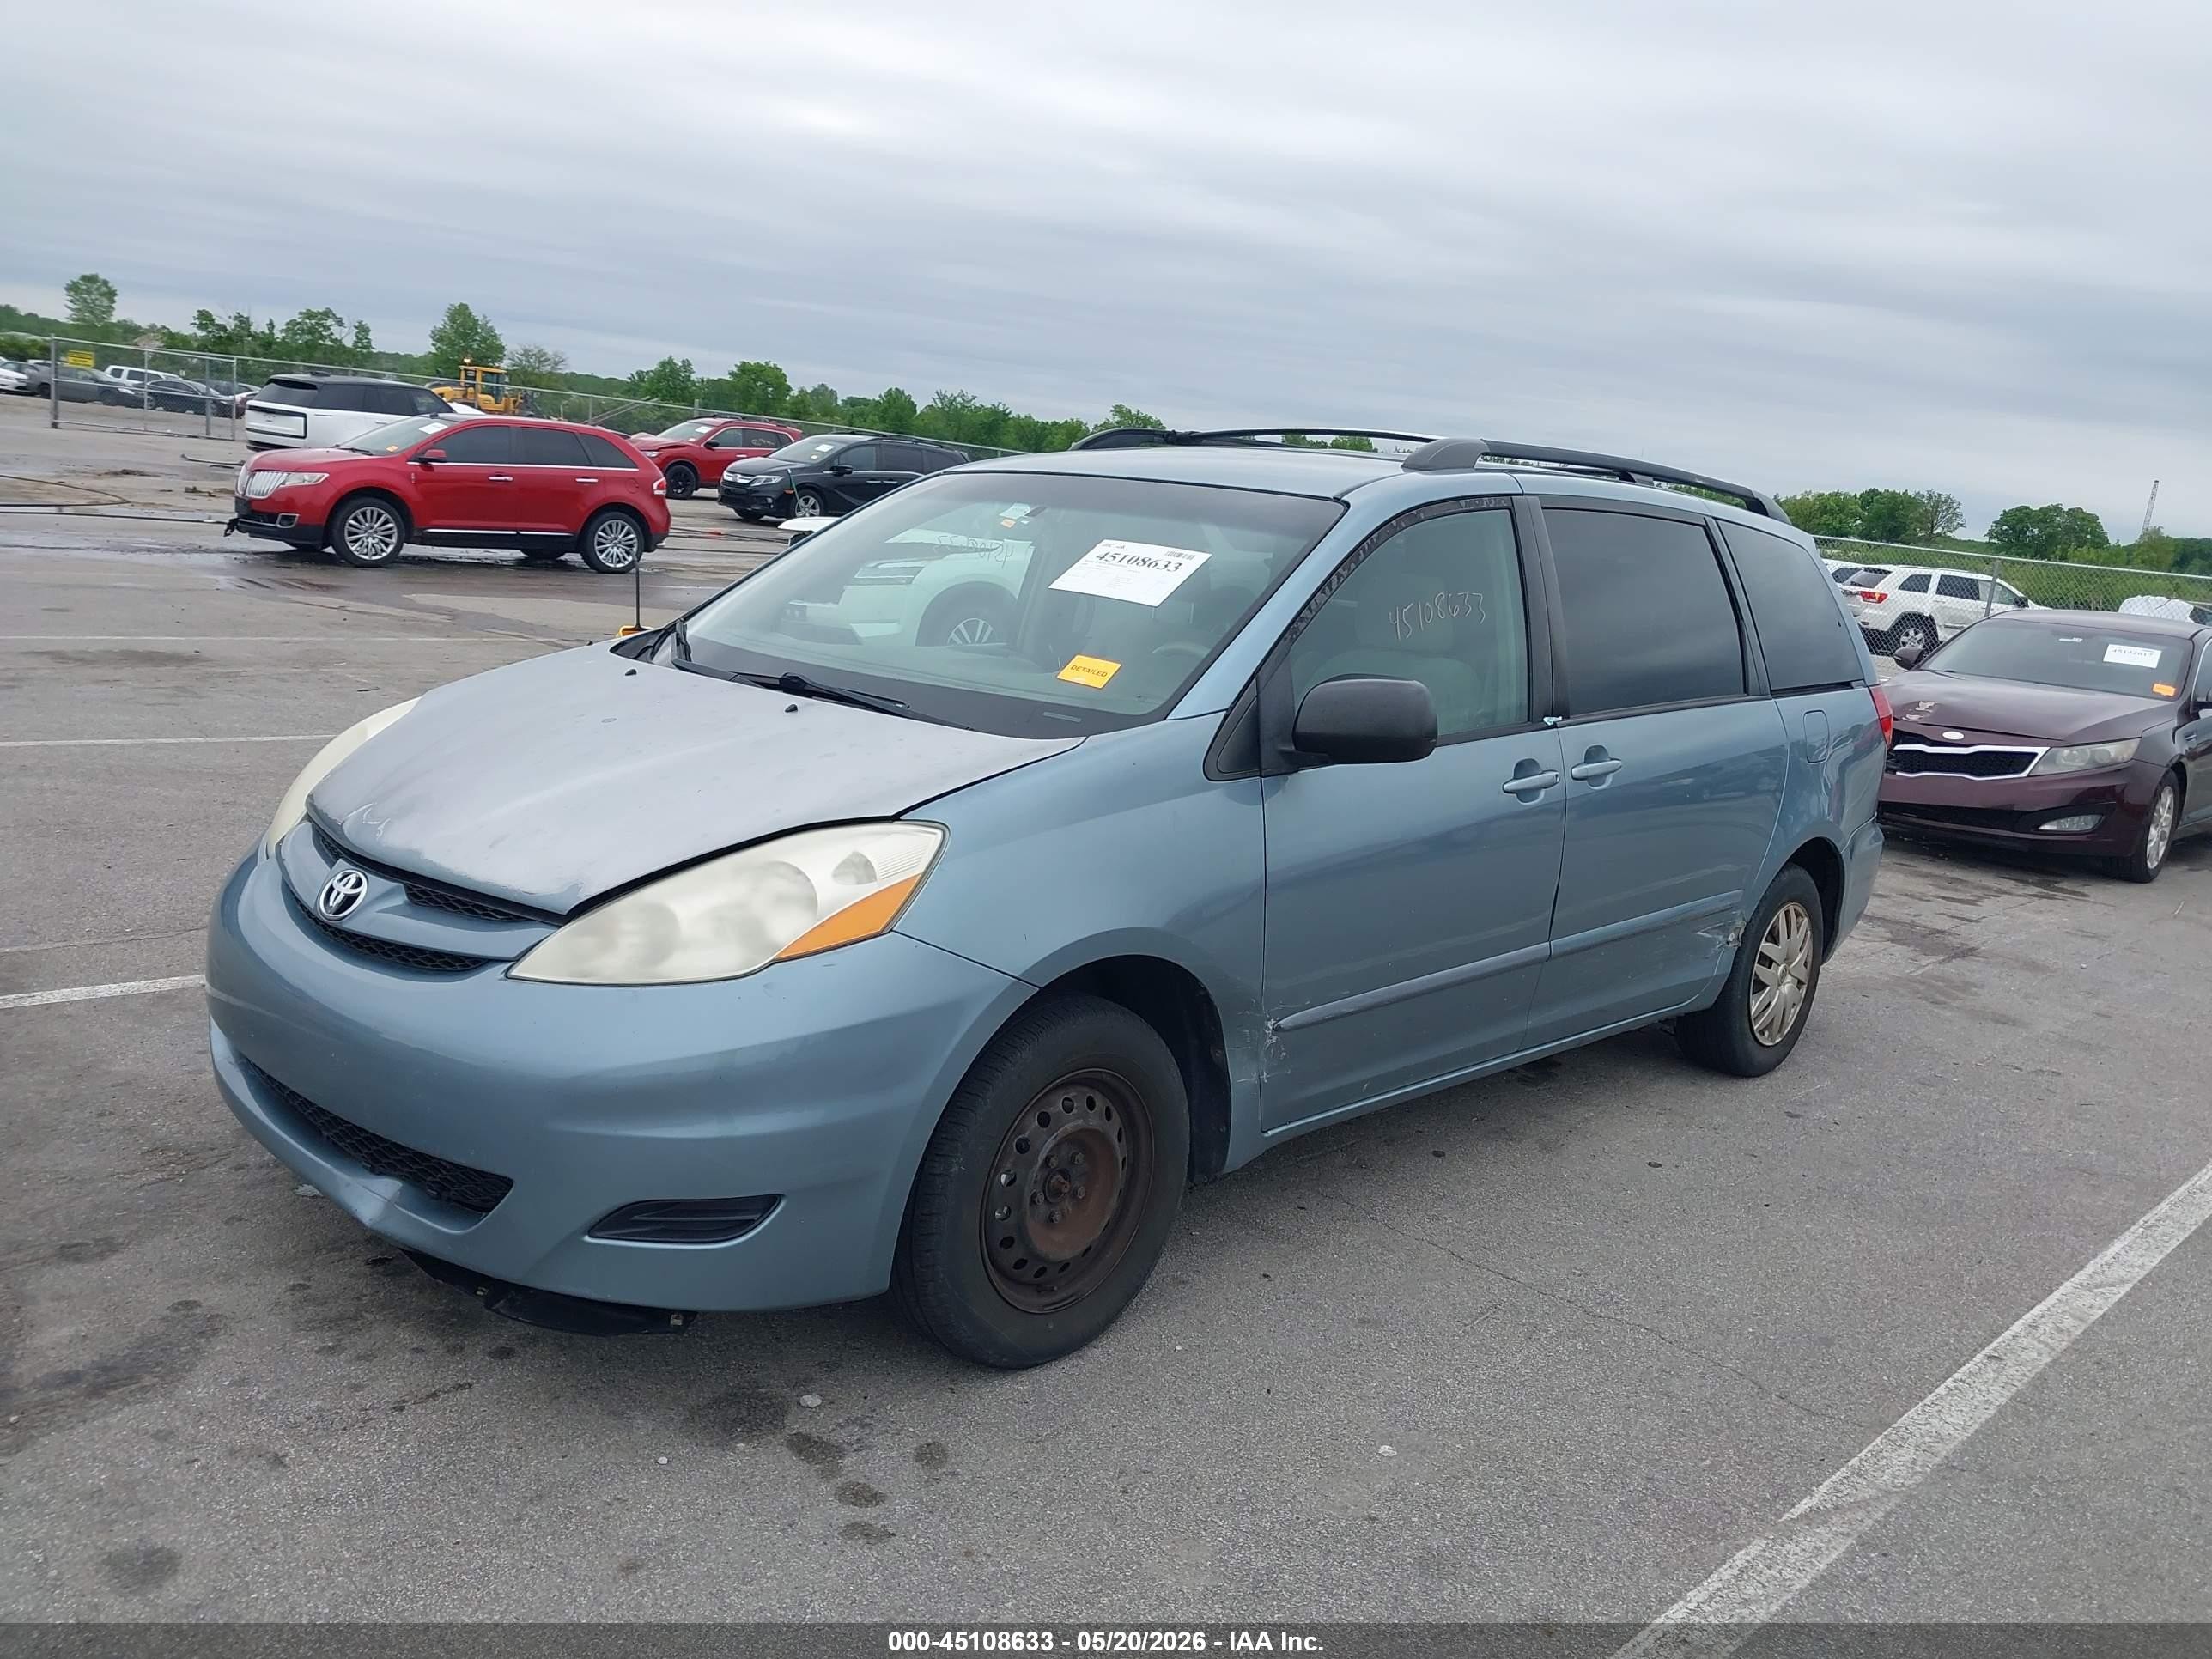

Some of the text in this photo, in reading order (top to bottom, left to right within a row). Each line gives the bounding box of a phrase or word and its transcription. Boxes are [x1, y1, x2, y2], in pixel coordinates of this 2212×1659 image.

[1096, 550, 1182, 573] 45108633
[1388, 592, 1486, 640] 45108633
[1070, 665, 1108, 678] DETAILED
